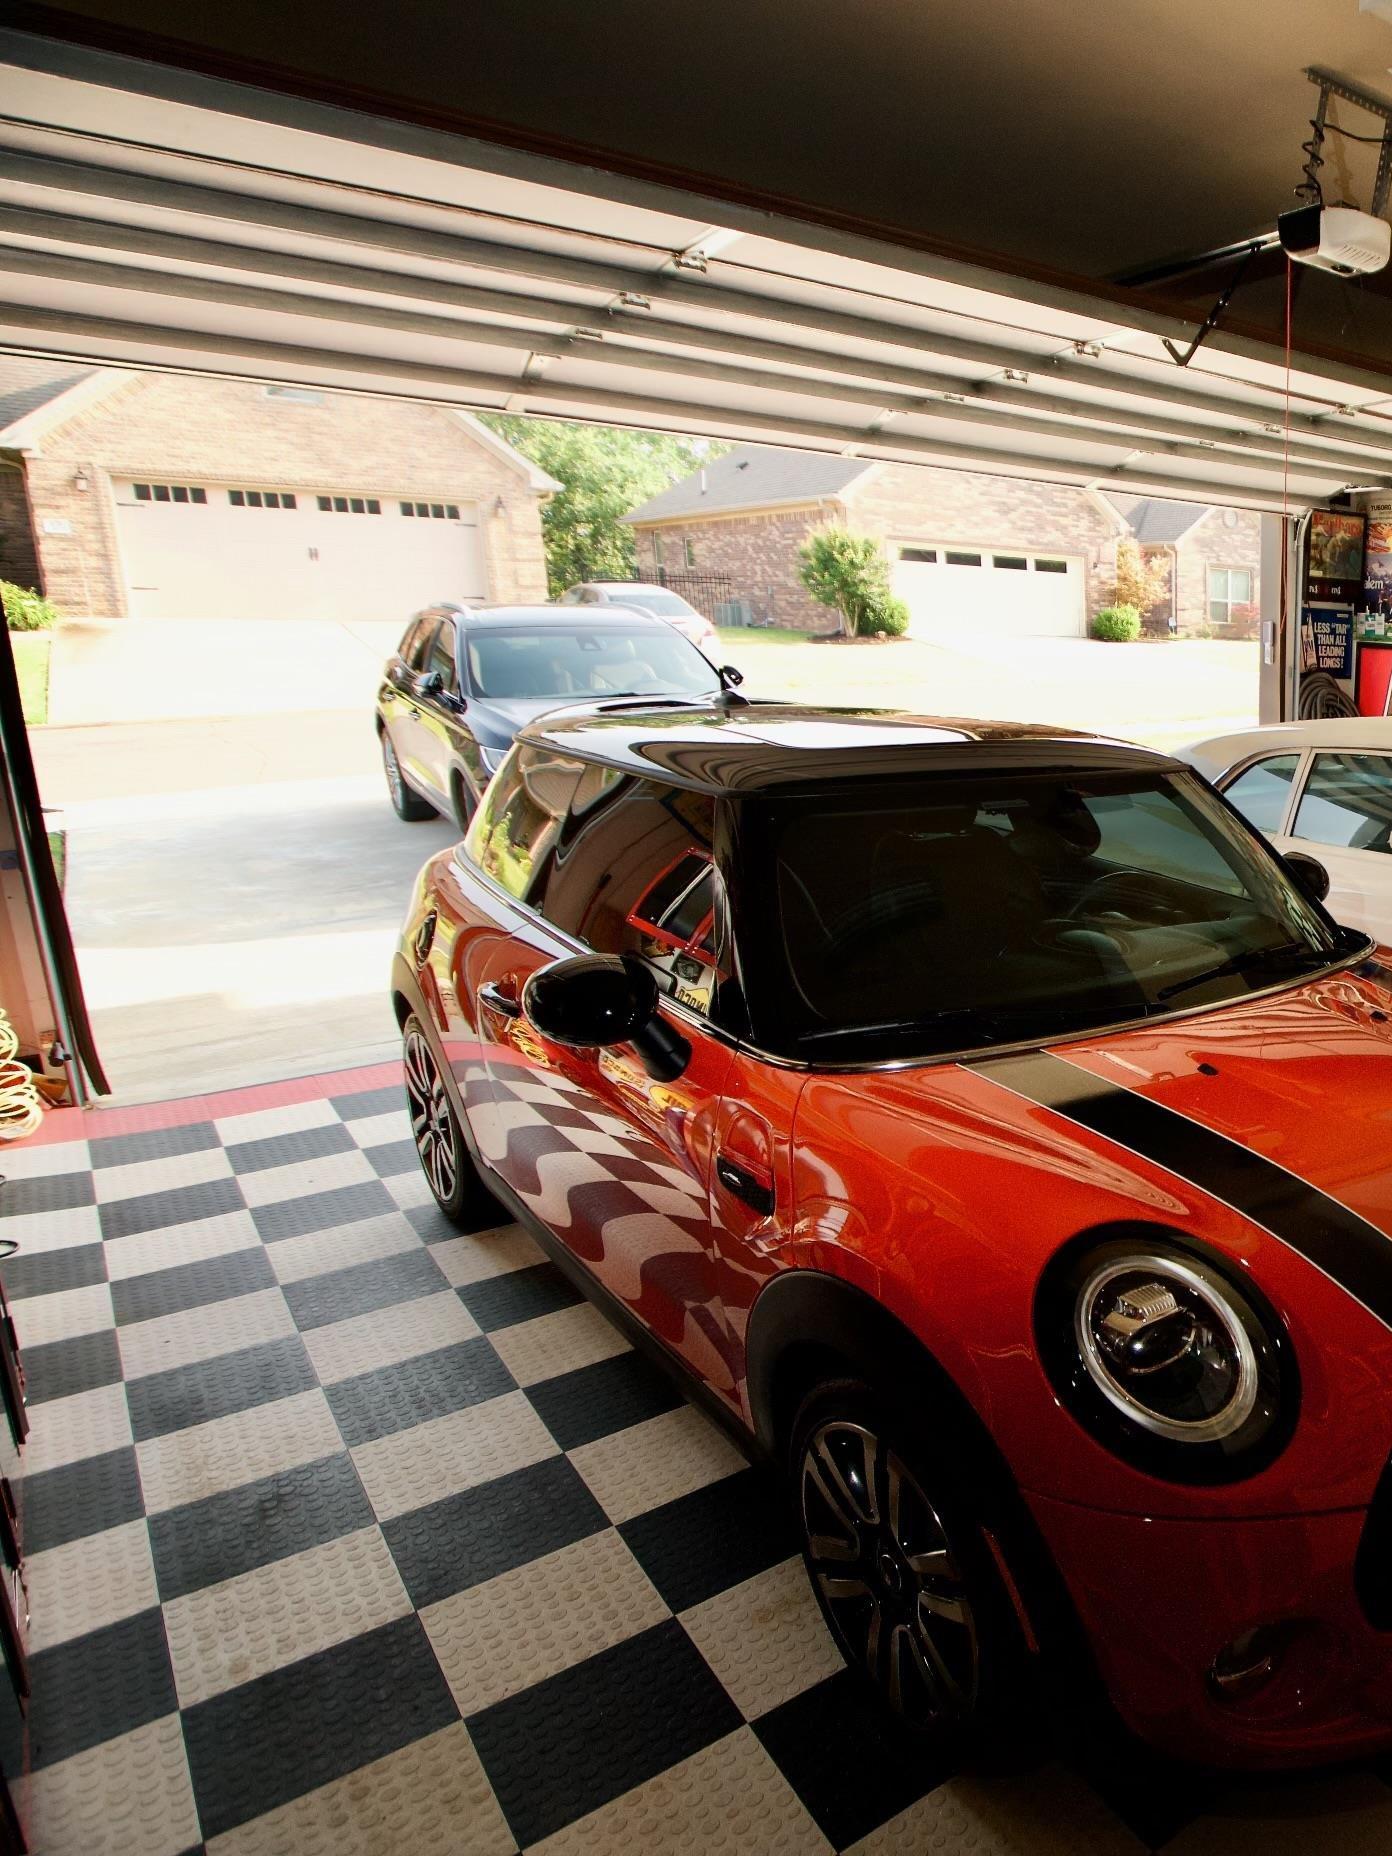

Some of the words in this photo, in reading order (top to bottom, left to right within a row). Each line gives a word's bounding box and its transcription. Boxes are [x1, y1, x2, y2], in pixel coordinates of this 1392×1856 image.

[1364, 576, 1384, 589] alem
[1314, 622, 1330, 633] LESS
[1317, 634, 1334, 645] THAN
[1335, 635, 1346, 646] ALL
[1318, 646, 1345, 657] LEADING
[1319, 657, 1344, 669] LONGS!
